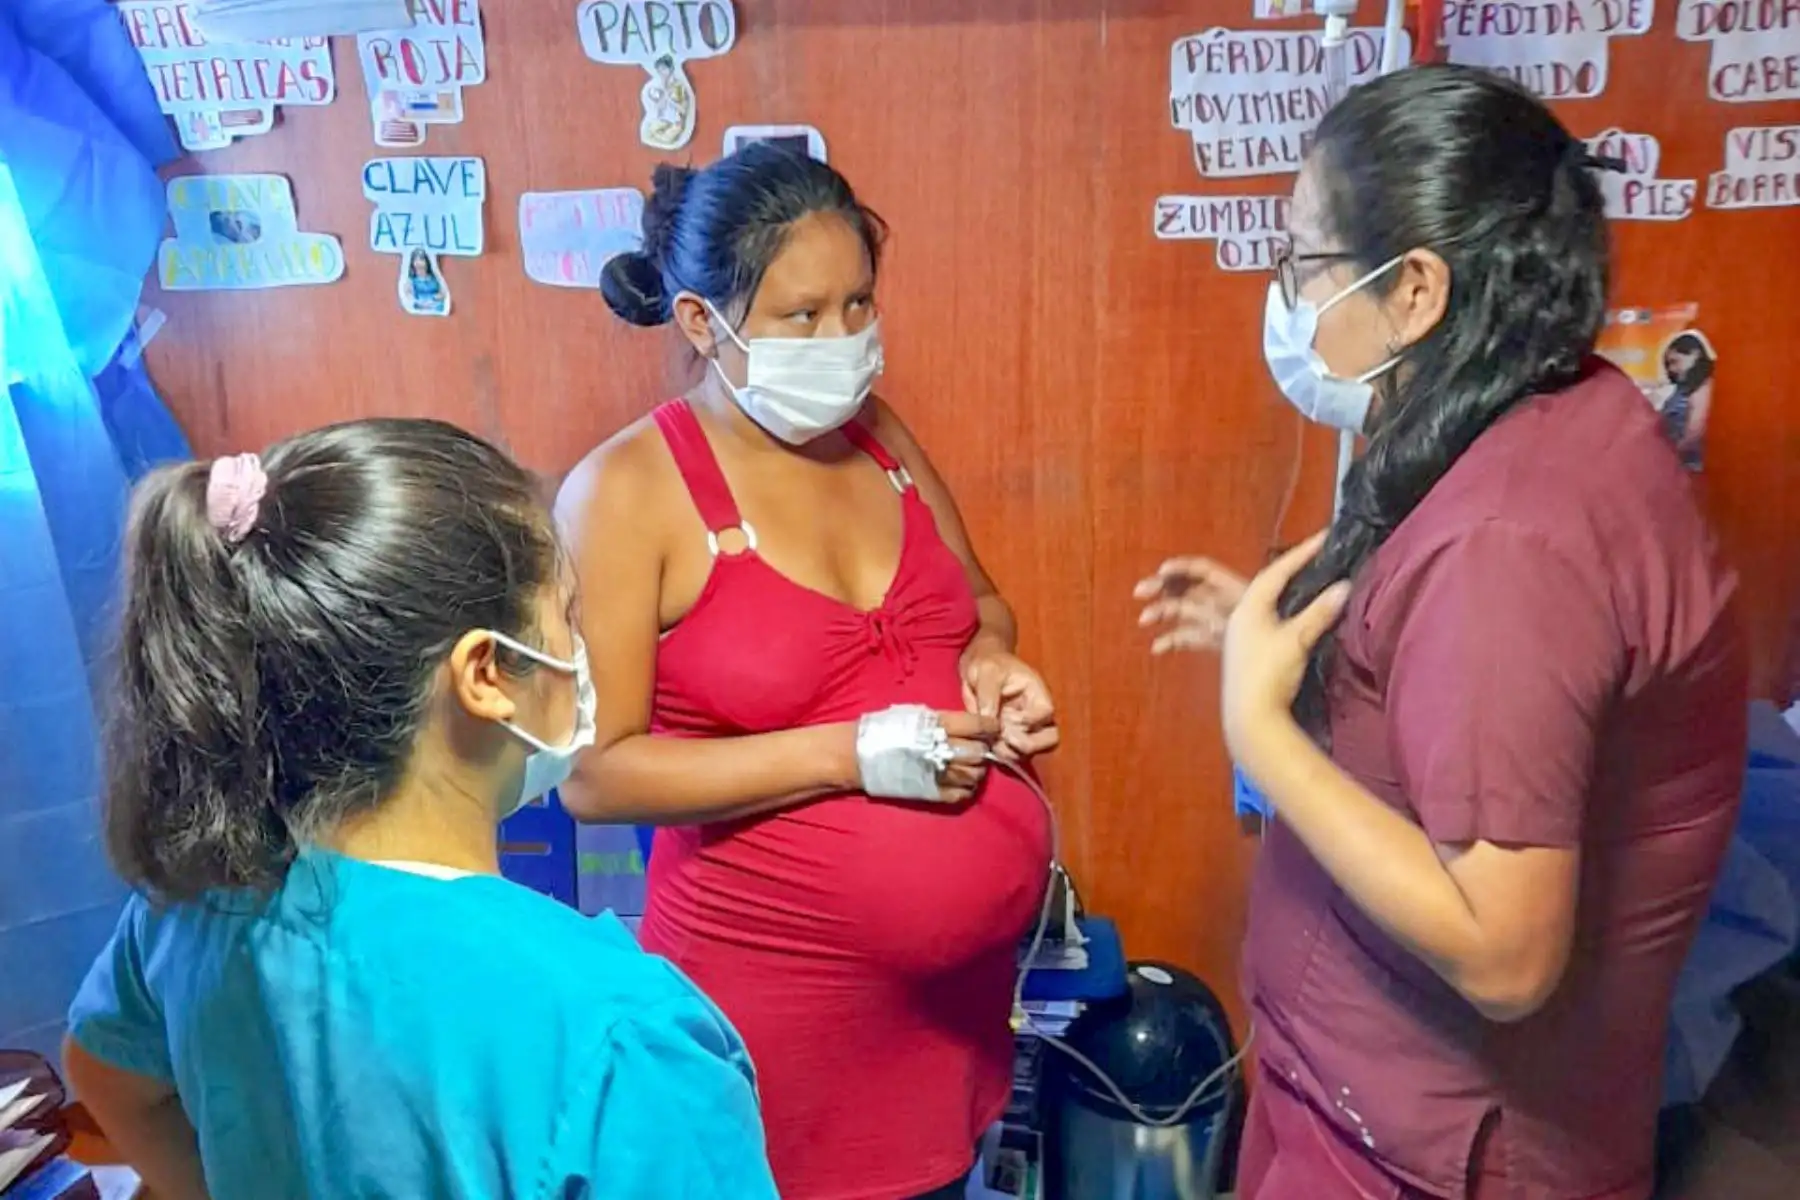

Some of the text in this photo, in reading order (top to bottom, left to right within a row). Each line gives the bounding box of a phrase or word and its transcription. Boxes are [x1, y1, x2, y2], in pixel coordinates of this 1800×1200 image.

[404, 0, 475, 26] AVE
[586, 0, 730, 53] PARTO
[1592, 0, 1642, 32] DE
[152, 57, 329, 102] TETRICAS
[367, 35, 480, 85] ROJA
[1714, 56, 1800, 98] CABE
[1171, 84, 1328, 125] MOVIMIEN
[364, 159, 480, 198] CLAVE
[1624, 180, 1693, 215] PIES
[374, 212, 477, 252] AZUL
[1157, 199, 1286, 236] ZUMBI
